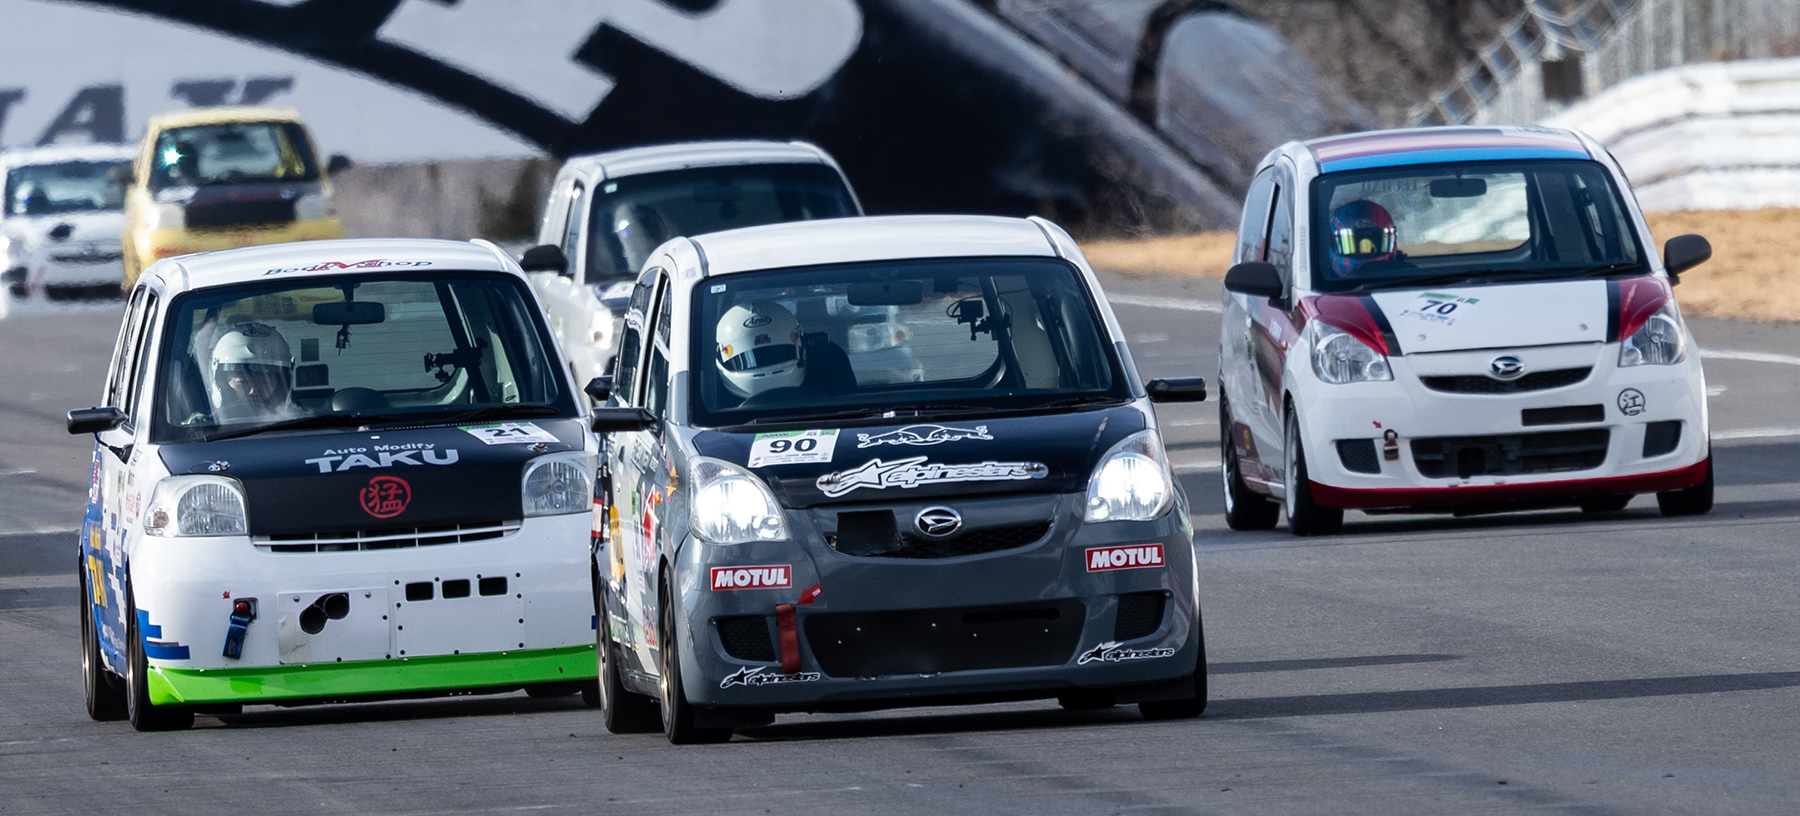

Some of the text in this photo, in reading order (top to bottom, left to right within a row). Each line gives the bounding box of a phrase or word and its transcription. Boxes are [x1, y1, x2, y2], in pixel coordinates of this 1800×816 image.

[1421, 300, 1458, 315] 70
[1622, 393, 1642, 409] 江
[485, 428, 530, 437] 21
[323, 442, 435, 456] Auto Modify
[769, 439, 818, 454] 90
[305, 450, 460, 474] TAKU
[887, 463, 1029, 484] alpinestars
[367, 482, 404, 515] 猛
[1090, 547, 1162, 568] MOTUL
[714, 568, 788, 588] MOTUL
